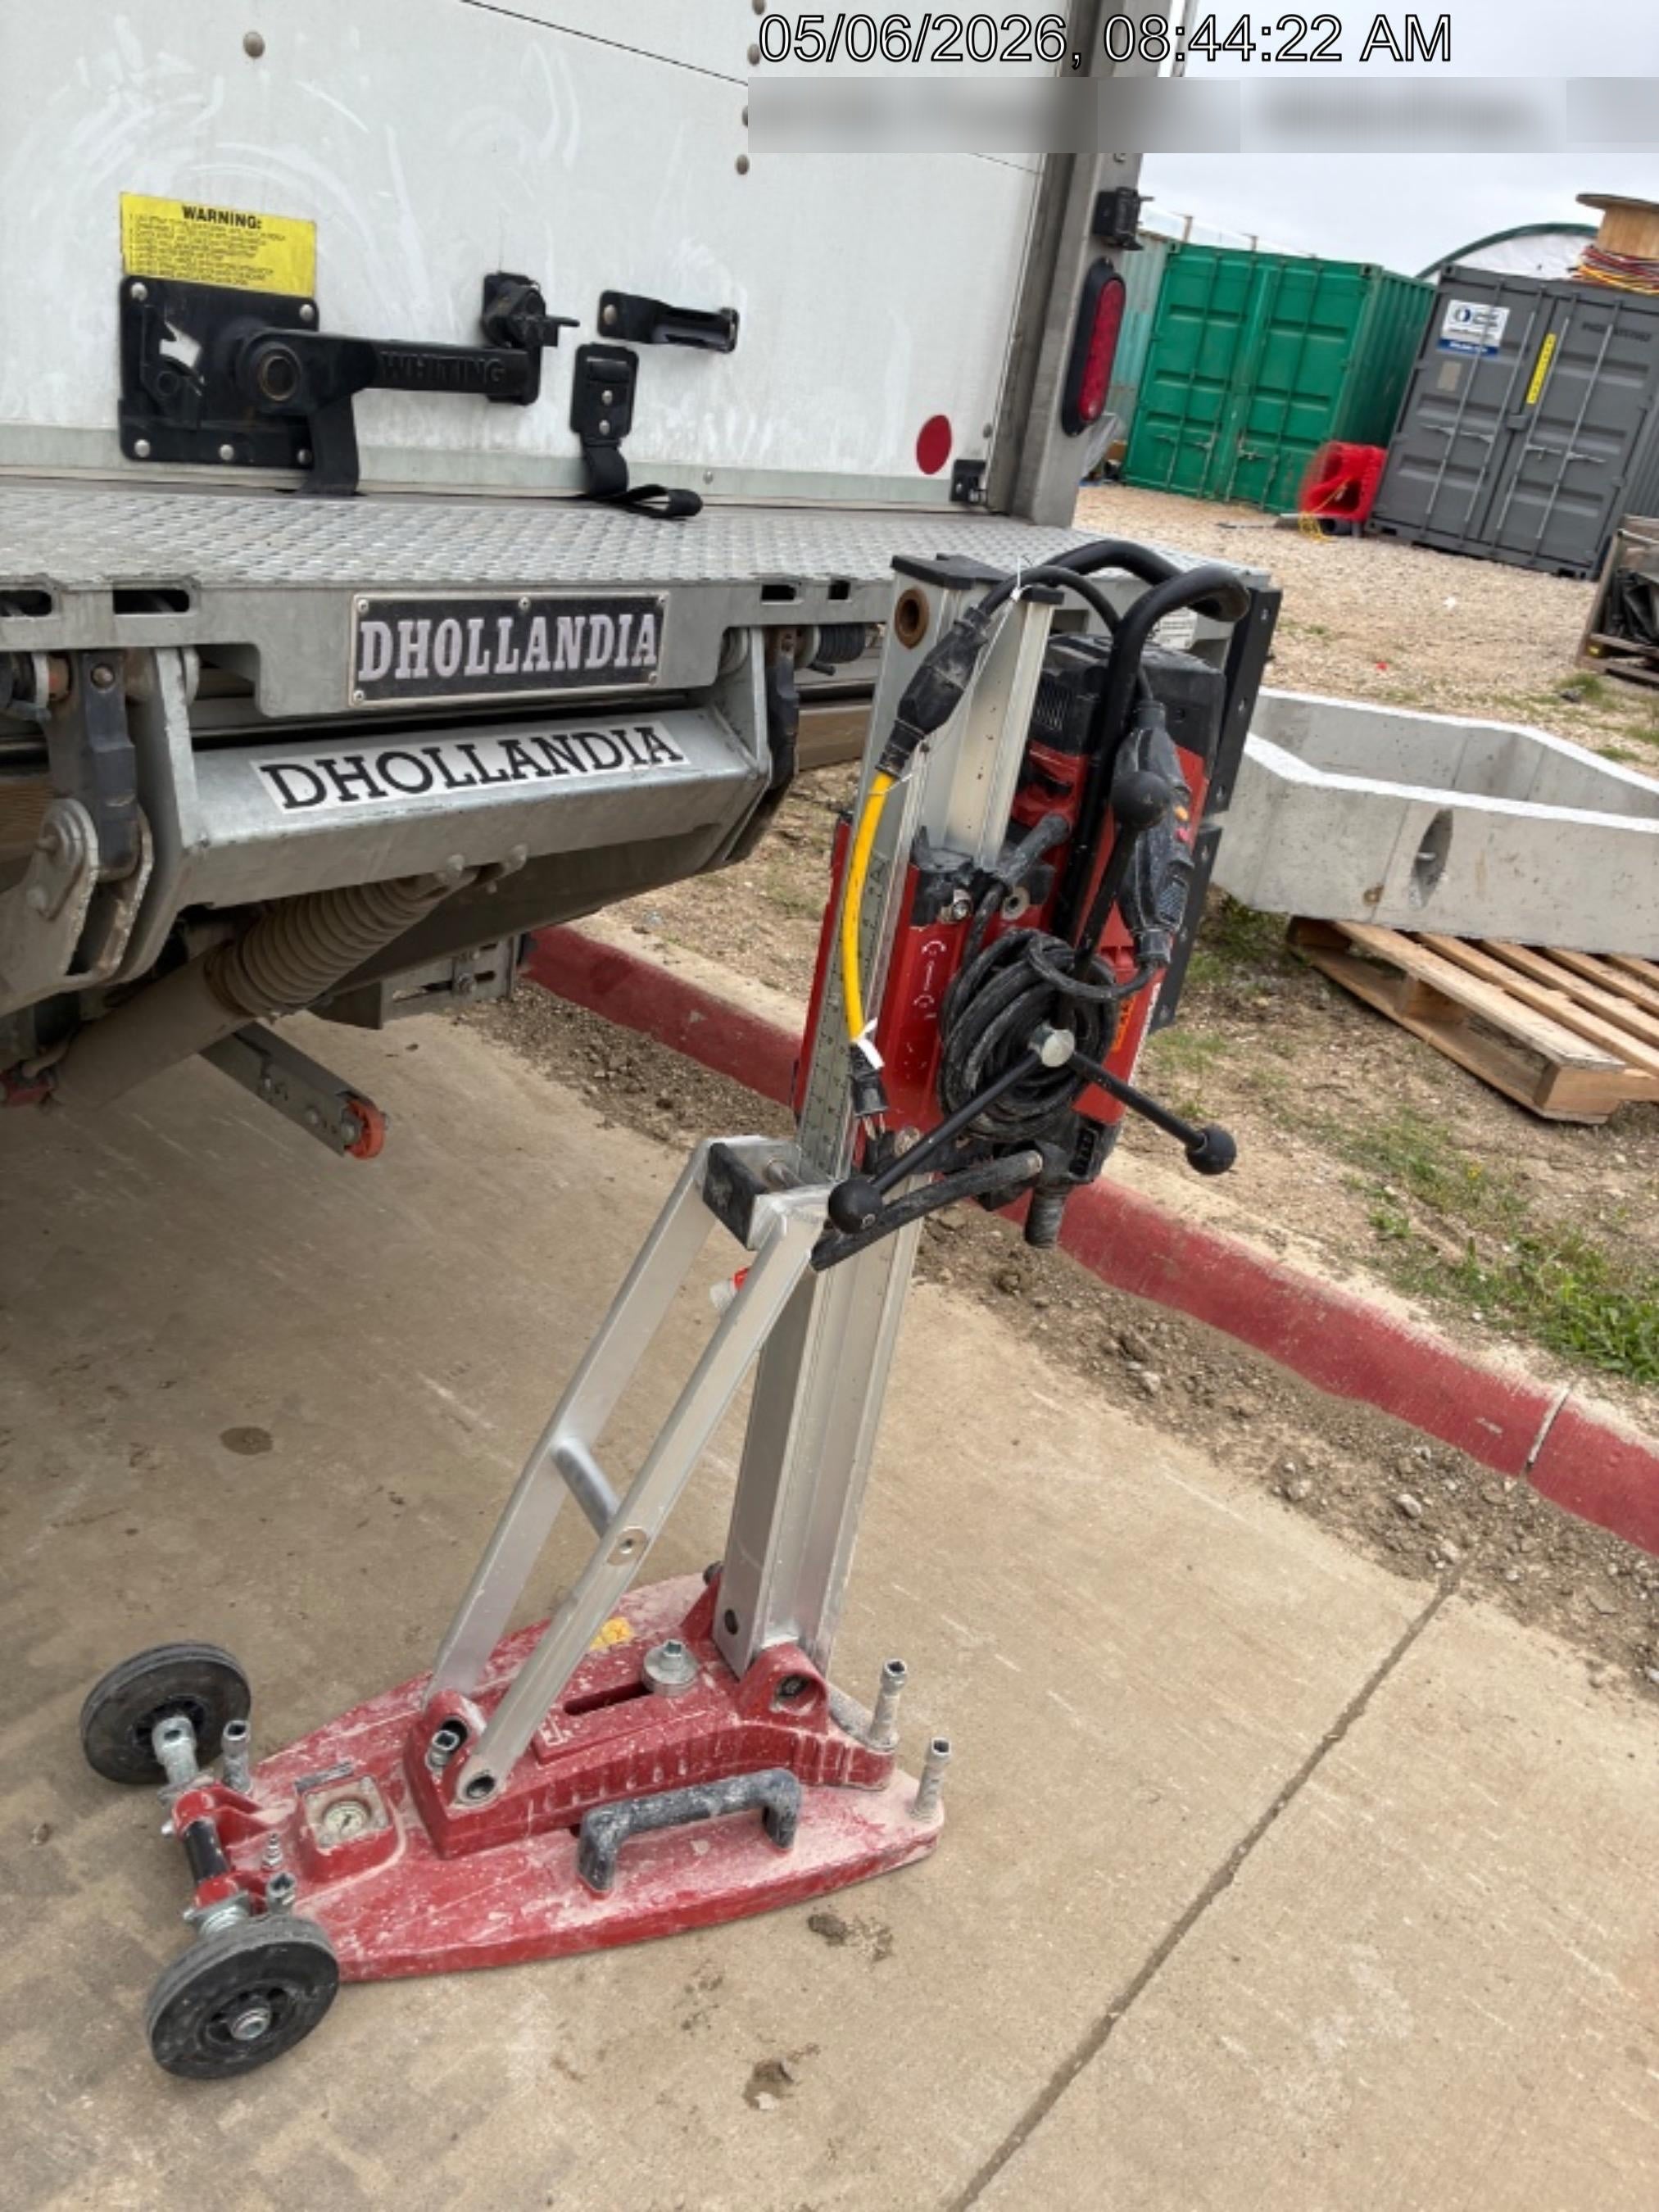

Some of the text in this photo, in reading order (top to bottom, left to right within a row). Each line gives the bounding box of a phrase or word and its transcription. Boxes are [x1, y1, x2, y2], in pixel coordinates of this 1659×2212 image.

[182, 206, 262, 229] WARNING:
[381, 353, 505, 383] WHITING
[358, 614, 656, 682] DHOLLANDIA
[260, 727, 683, 809] DHOLLANDIA
